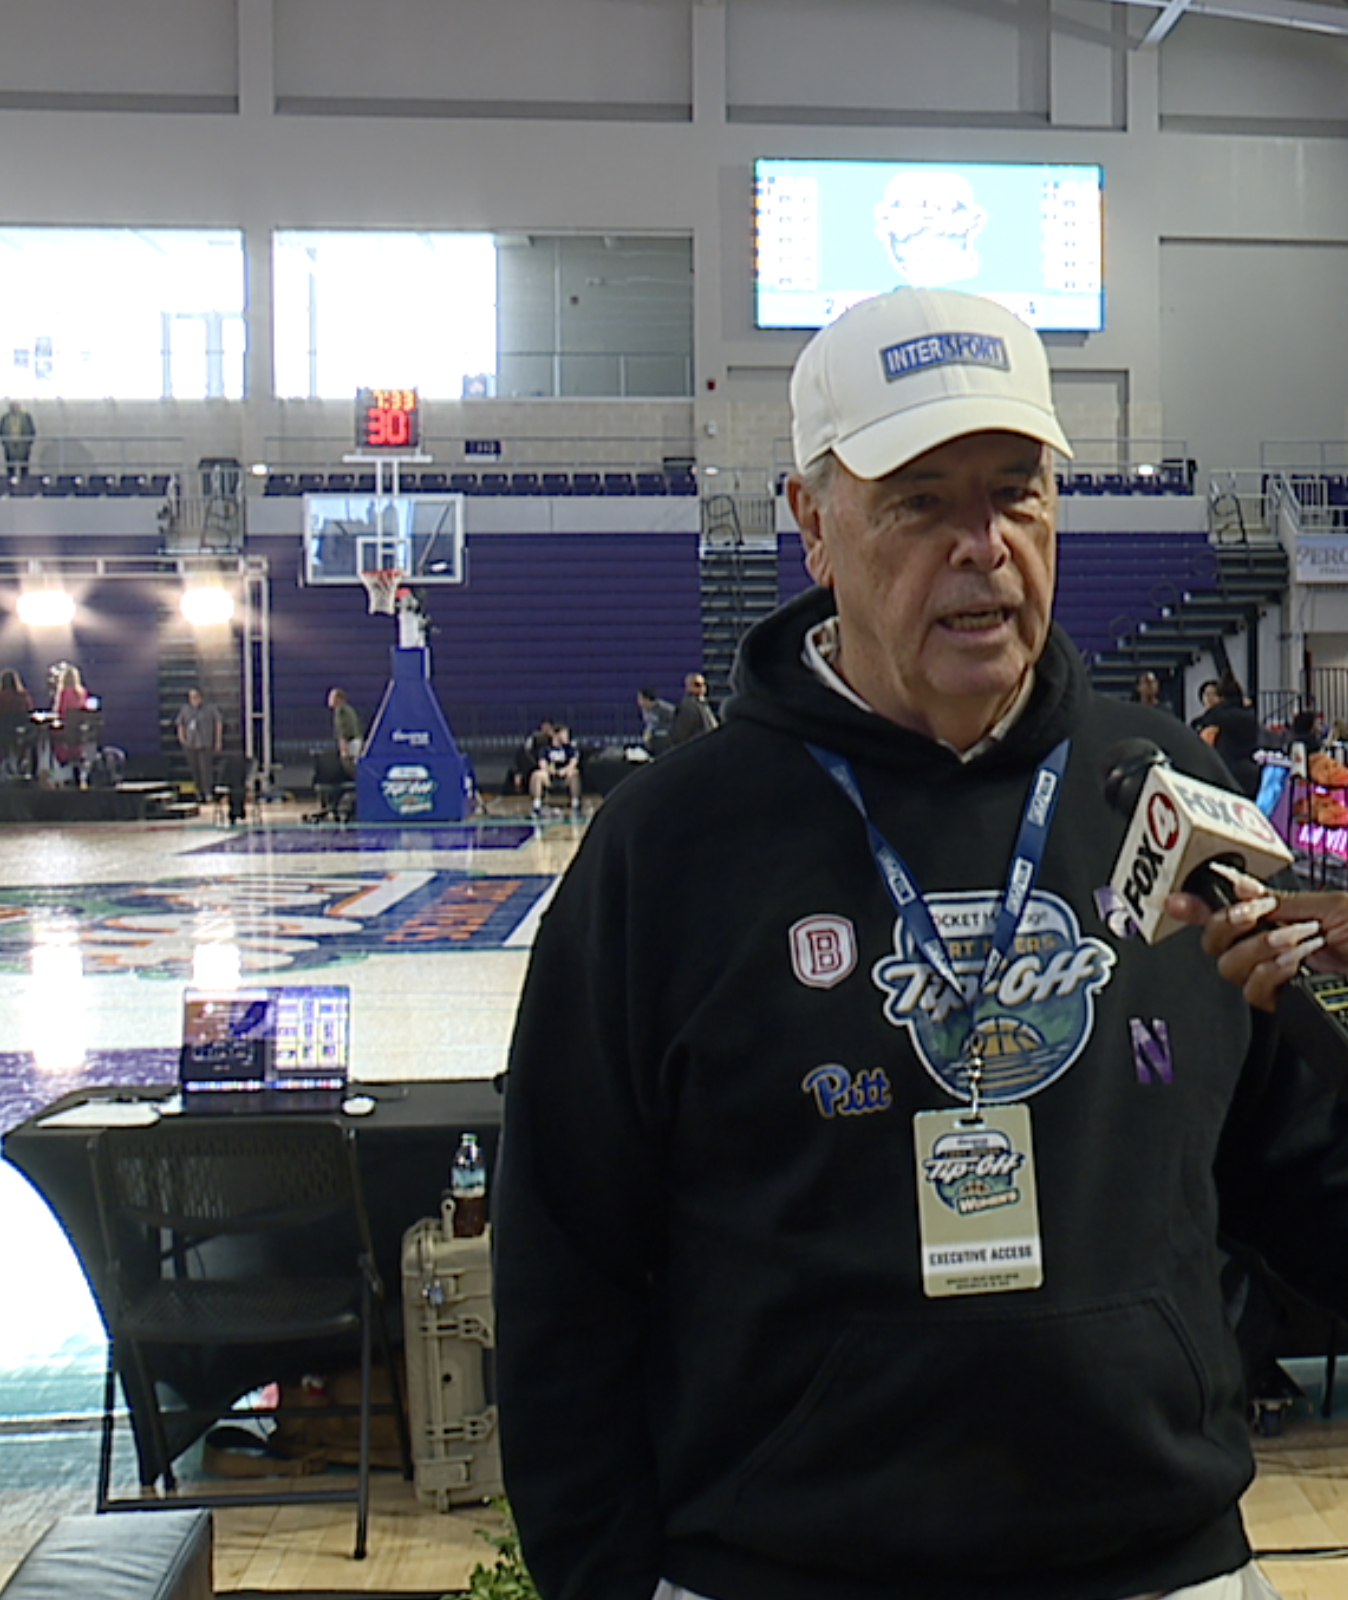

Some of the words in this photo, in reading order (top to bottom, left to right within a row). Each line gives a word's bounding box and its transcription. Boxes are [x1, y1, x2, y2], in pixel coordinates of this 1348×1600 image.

[368, 408, 408, 444] 30
[1123, 832, 1165, 919] FOX
[935, 911, 981, 927] OCKET
[806, 928, 843, 975] B
[883, 946, 1101, 1021] Tip-Off
[1129, 1017, 1172, 1084] N
[802, 1063, 890, 1119] Pitt
[925, 1153, 1020, 1183] Tip-Off
[929, 1249, 988, 1266] EXECUTIVE
[991, 1245, 1034, 1261] ACCESS
